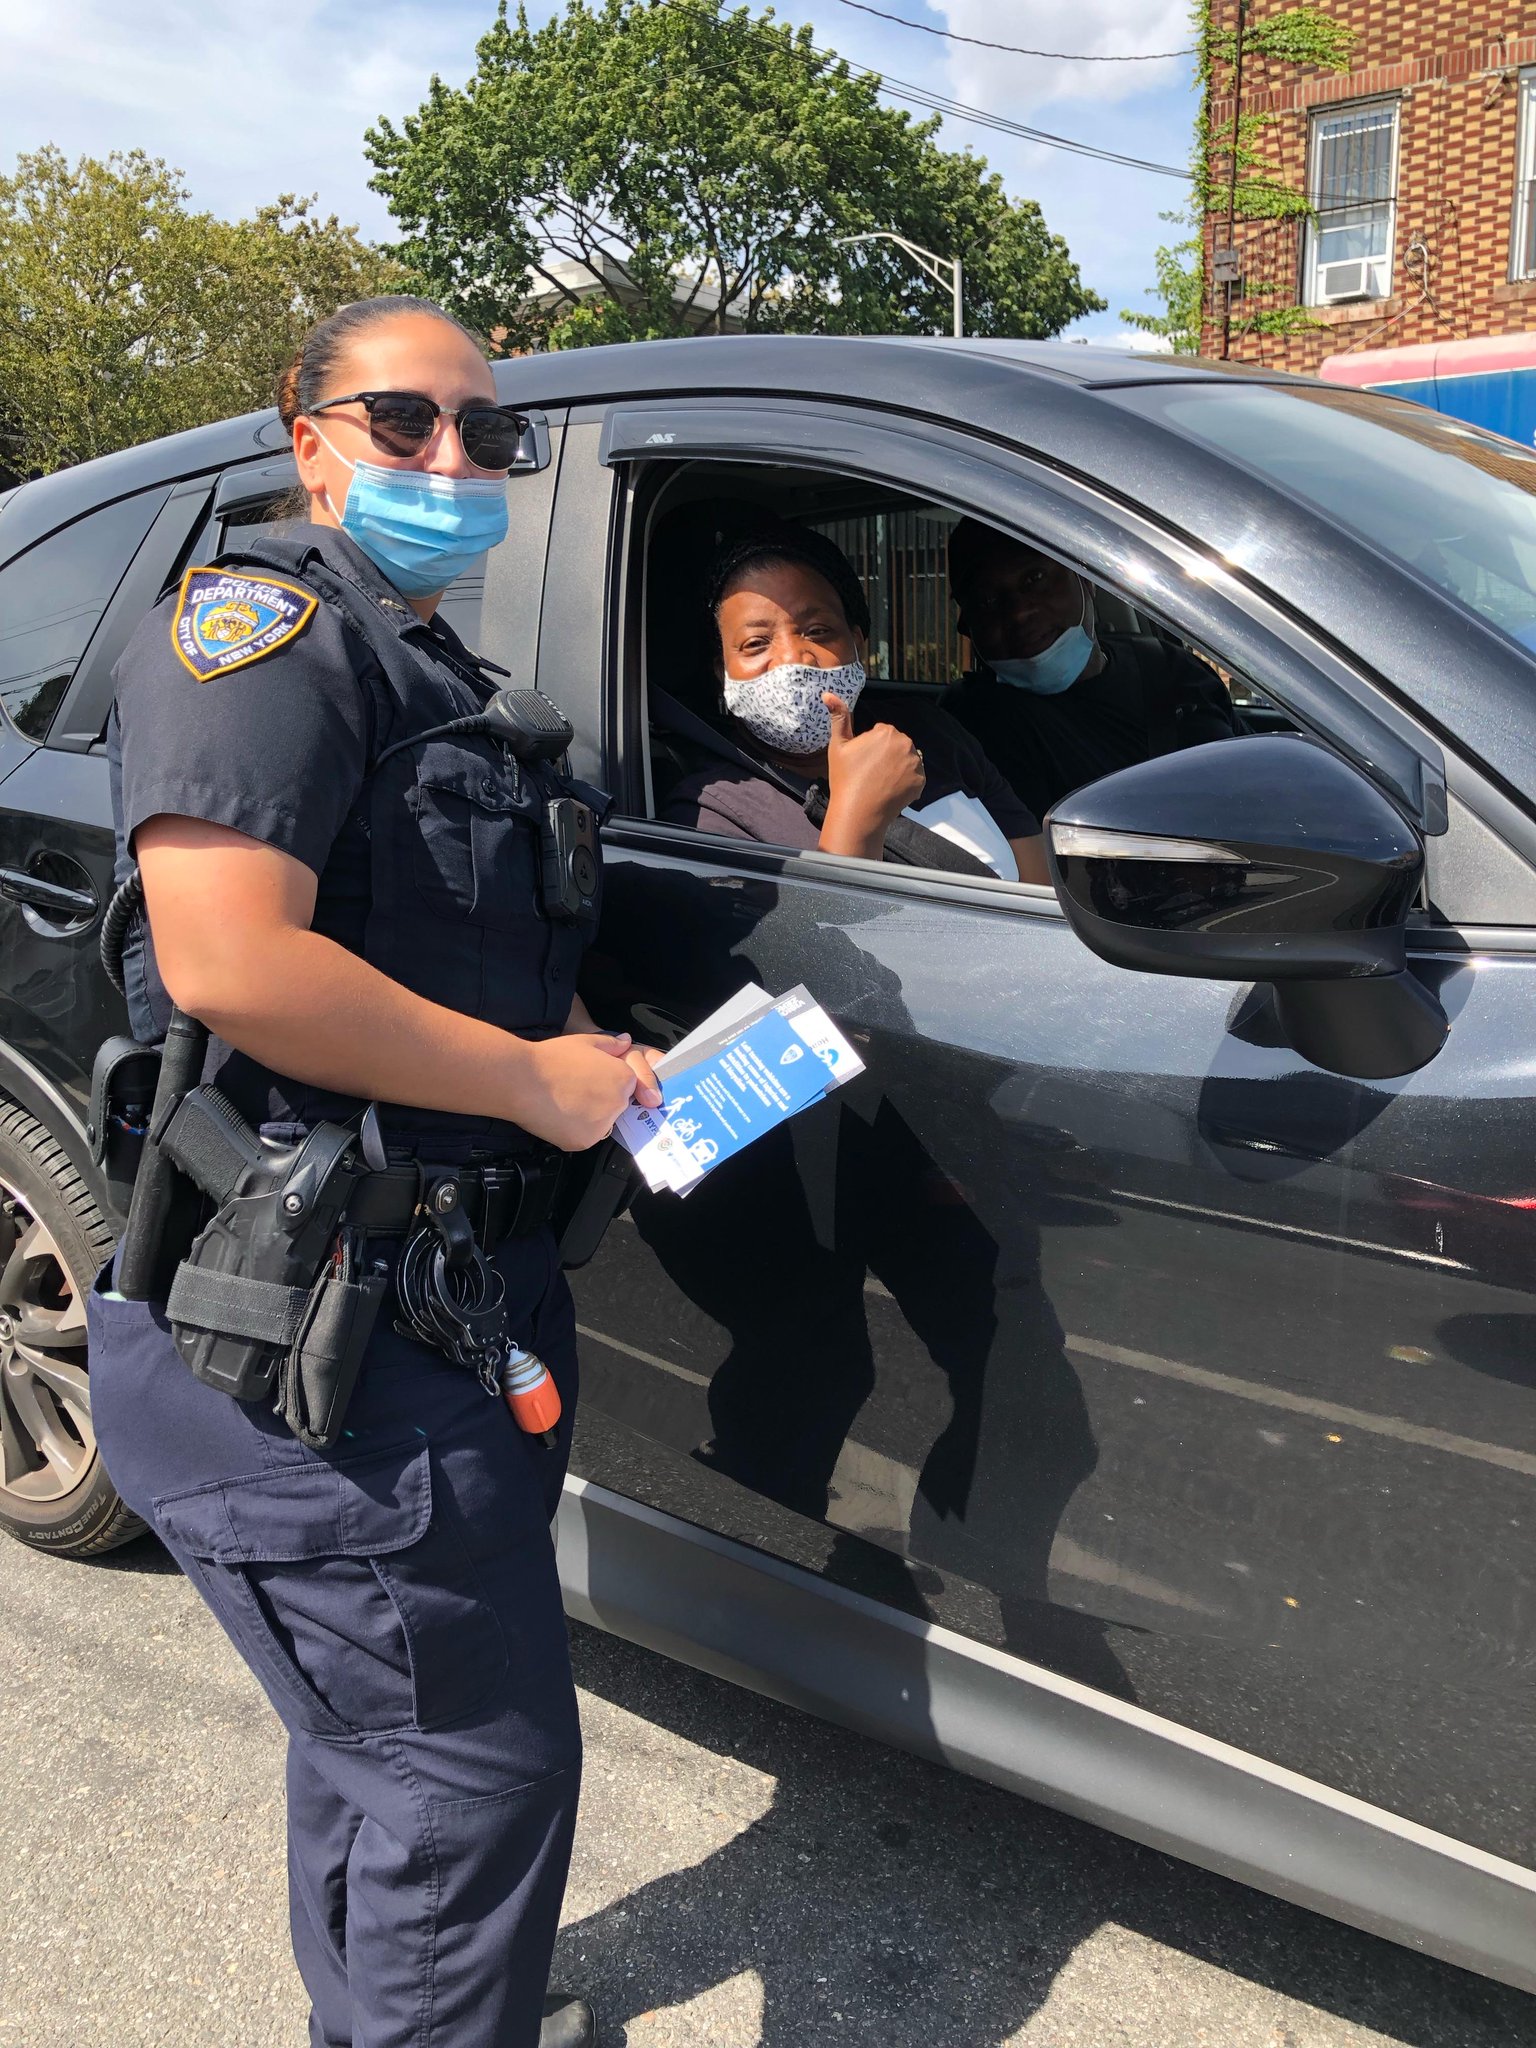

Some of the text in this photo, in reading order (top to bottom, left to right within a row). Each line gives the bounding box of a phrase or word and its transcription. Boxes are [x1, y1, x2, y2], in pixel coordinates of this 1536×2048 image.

[191, 586, 299, 617] DEPARTMENT
[218, 577, 283, 597] POLICE
[179, 616, 199, 656] CITY OF
[218, 622, 294, 666] NEW YORK
